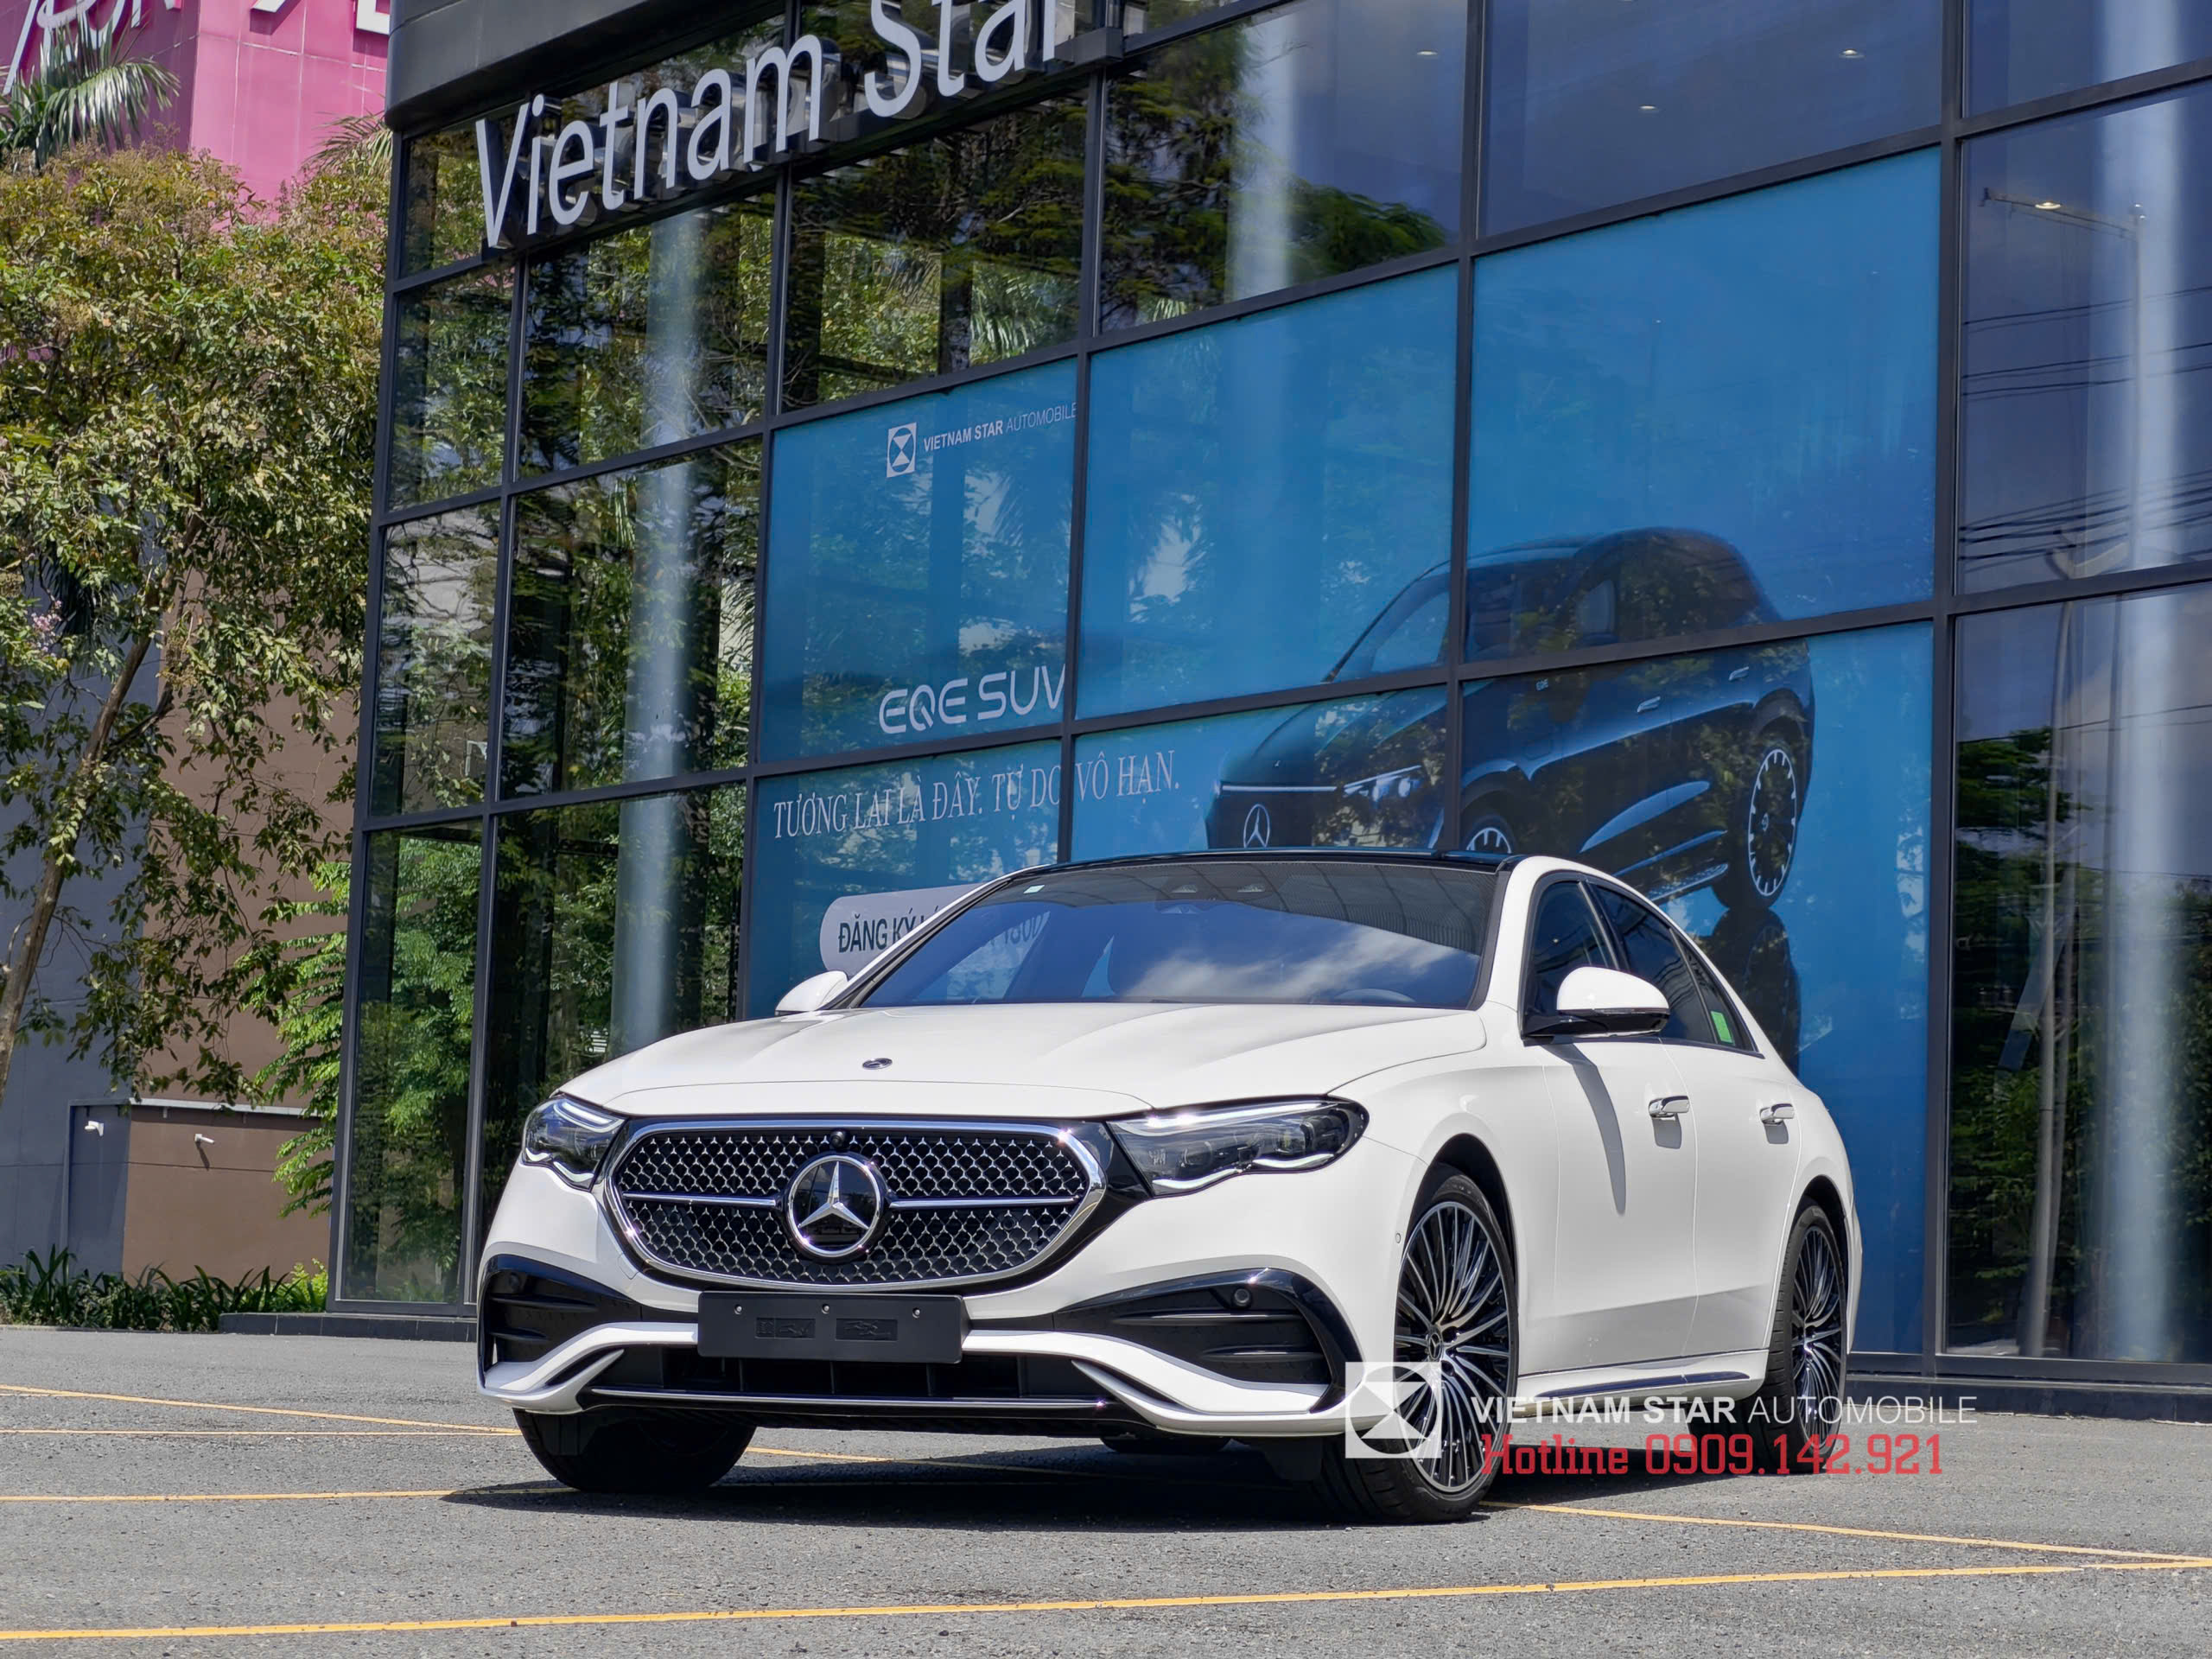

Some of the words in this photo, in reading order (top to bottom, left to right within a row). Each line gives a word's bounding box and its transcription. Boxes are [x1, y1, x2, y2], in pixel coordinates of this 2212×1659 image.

[475, 35, 822, 249] Vietnam
[924, 427, 972, 453] VIETNAM
[974, 420, 1004, 441] STAR
[1006, 402, 1077, 433] AUTOMOBILE
[879, 677, 969, 734] EQE
[977, 663, 1065, 721] SUV
[773, 791, 848, 839] TƯƠNG
[853, 789, 893, 830] LAI
[896, 775, 926, 824] LÀ
[931, 771, 983, 821] ĐÂY.
[992, 763, 1024, 821] TỰ
[1075, 750, 1109, 802] VÔ
[1116, 750, 1179, 804] HẠN.
[838, 913, 888, 953] ĐĂNG
